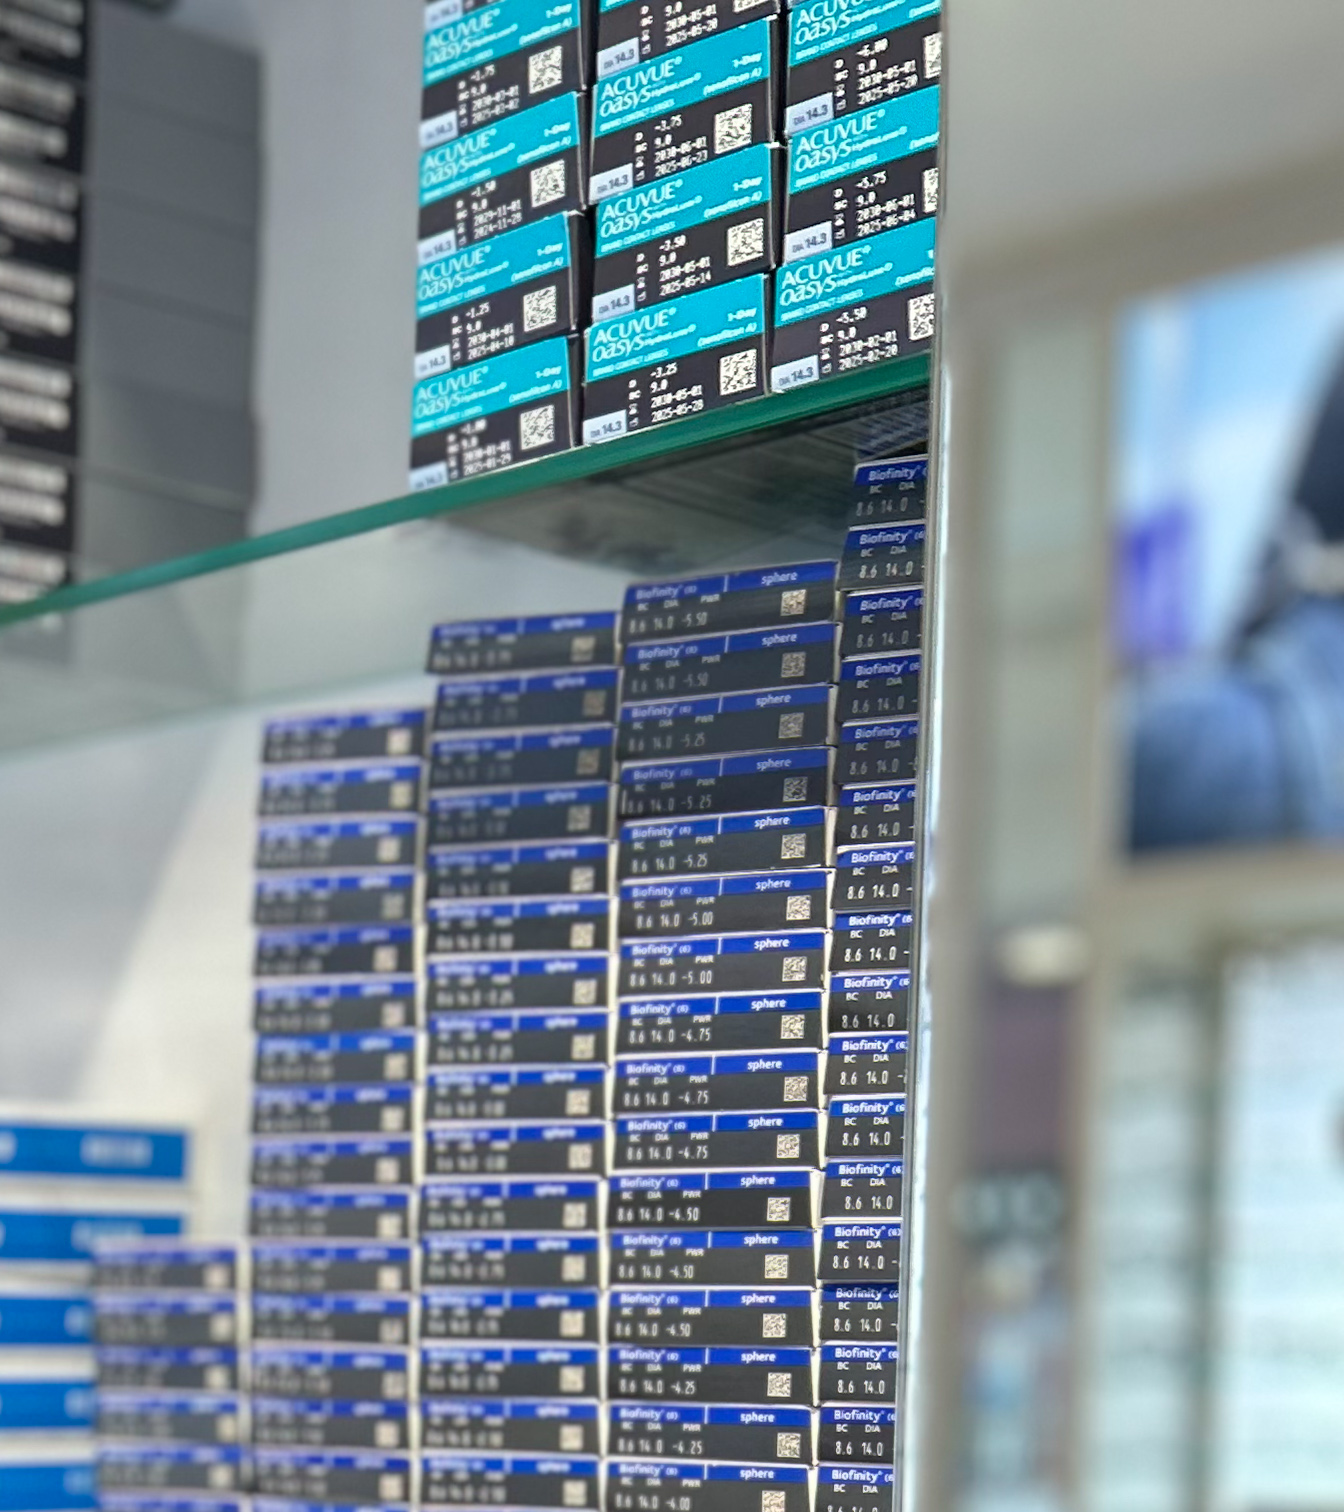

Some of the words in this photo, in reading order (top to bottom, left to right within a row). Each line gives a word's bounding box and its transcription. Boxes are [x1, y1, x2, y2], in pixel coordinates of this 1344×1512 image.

[426, 13, 494, 48] ACUVUE
[601, 60, 675, 101] ACUVUE
[806, 105, 827, 120] 14.3
[797, 112, 878, 155] ACUVUE
[422, 133, 492, 170] ACUVUE
[602, 183, 676, 222] ACUVUE
[419, 248, 485, 281] ACUVUE
[781, 250, 863, 290] ACUVUE
[594, 310, 669, 346] ACUVUE
[791, 367, 813, 381] 14.3
[417, 369, 483, 400] ACUVUE
[869, 467, 916, 481] Biofinity
[859, 532, 908, 544] Biofinity
[762, 570, 798, 585] sphere
[860, 597, 908, 610] Biofinity
[762, 633, 798, 646] sphere
[855, 662, 905, 676] Biofinity
[756, 693, 791, 707] sphere
[854, 726, 903, 739] Biofinity
[756, 757, 791, 770] sphere
[853, 790, 901, 802] Biofinity
[754, 815, 790, 829] sphere
[851, 851, 899, 864] Biofinity
[755, 877, 791, 891] sphere
[849, 914, 896, 927] Biofinity
[754, 938, 790, 950] sphere
[844, 977, 892, 990] Biofinity
[846, 992, 858, 1000] BC
[876, 991, 892, 999] DIA
[751, 998, 787, 1010] sphere
[842, 1040, 888, 1052] Biofinity
[747, 1059, 783, 1071] sphere
[842, 1103, 889, 1114] Biofinity
[748, 1117, 782, 1129] sphere
[839, 1165, 885, 1176] Biofinity
[741, 1175, 775, 1187] sphere
[835, 1227, 882, 1238] Biofinity
[744, 1234, 778, 1246] sphere
[837, 1241, 849, 1249] BC
[741, 1293, 775, 1305] sphere
[836, 1289, 882, 1299] Biofinity
[838, 1302, 850, 1310] BC
[741, 1352, 775, 1362] sphere
[835, 1348, 882, 1359] Biofinity
[740, 1412, 774, 1423] sphere
[834, 1410, 881, 1421] Biofinity
[740, 1469, 774, 1479] sphere
[831, 1470, 878, 1481] Biofinity
